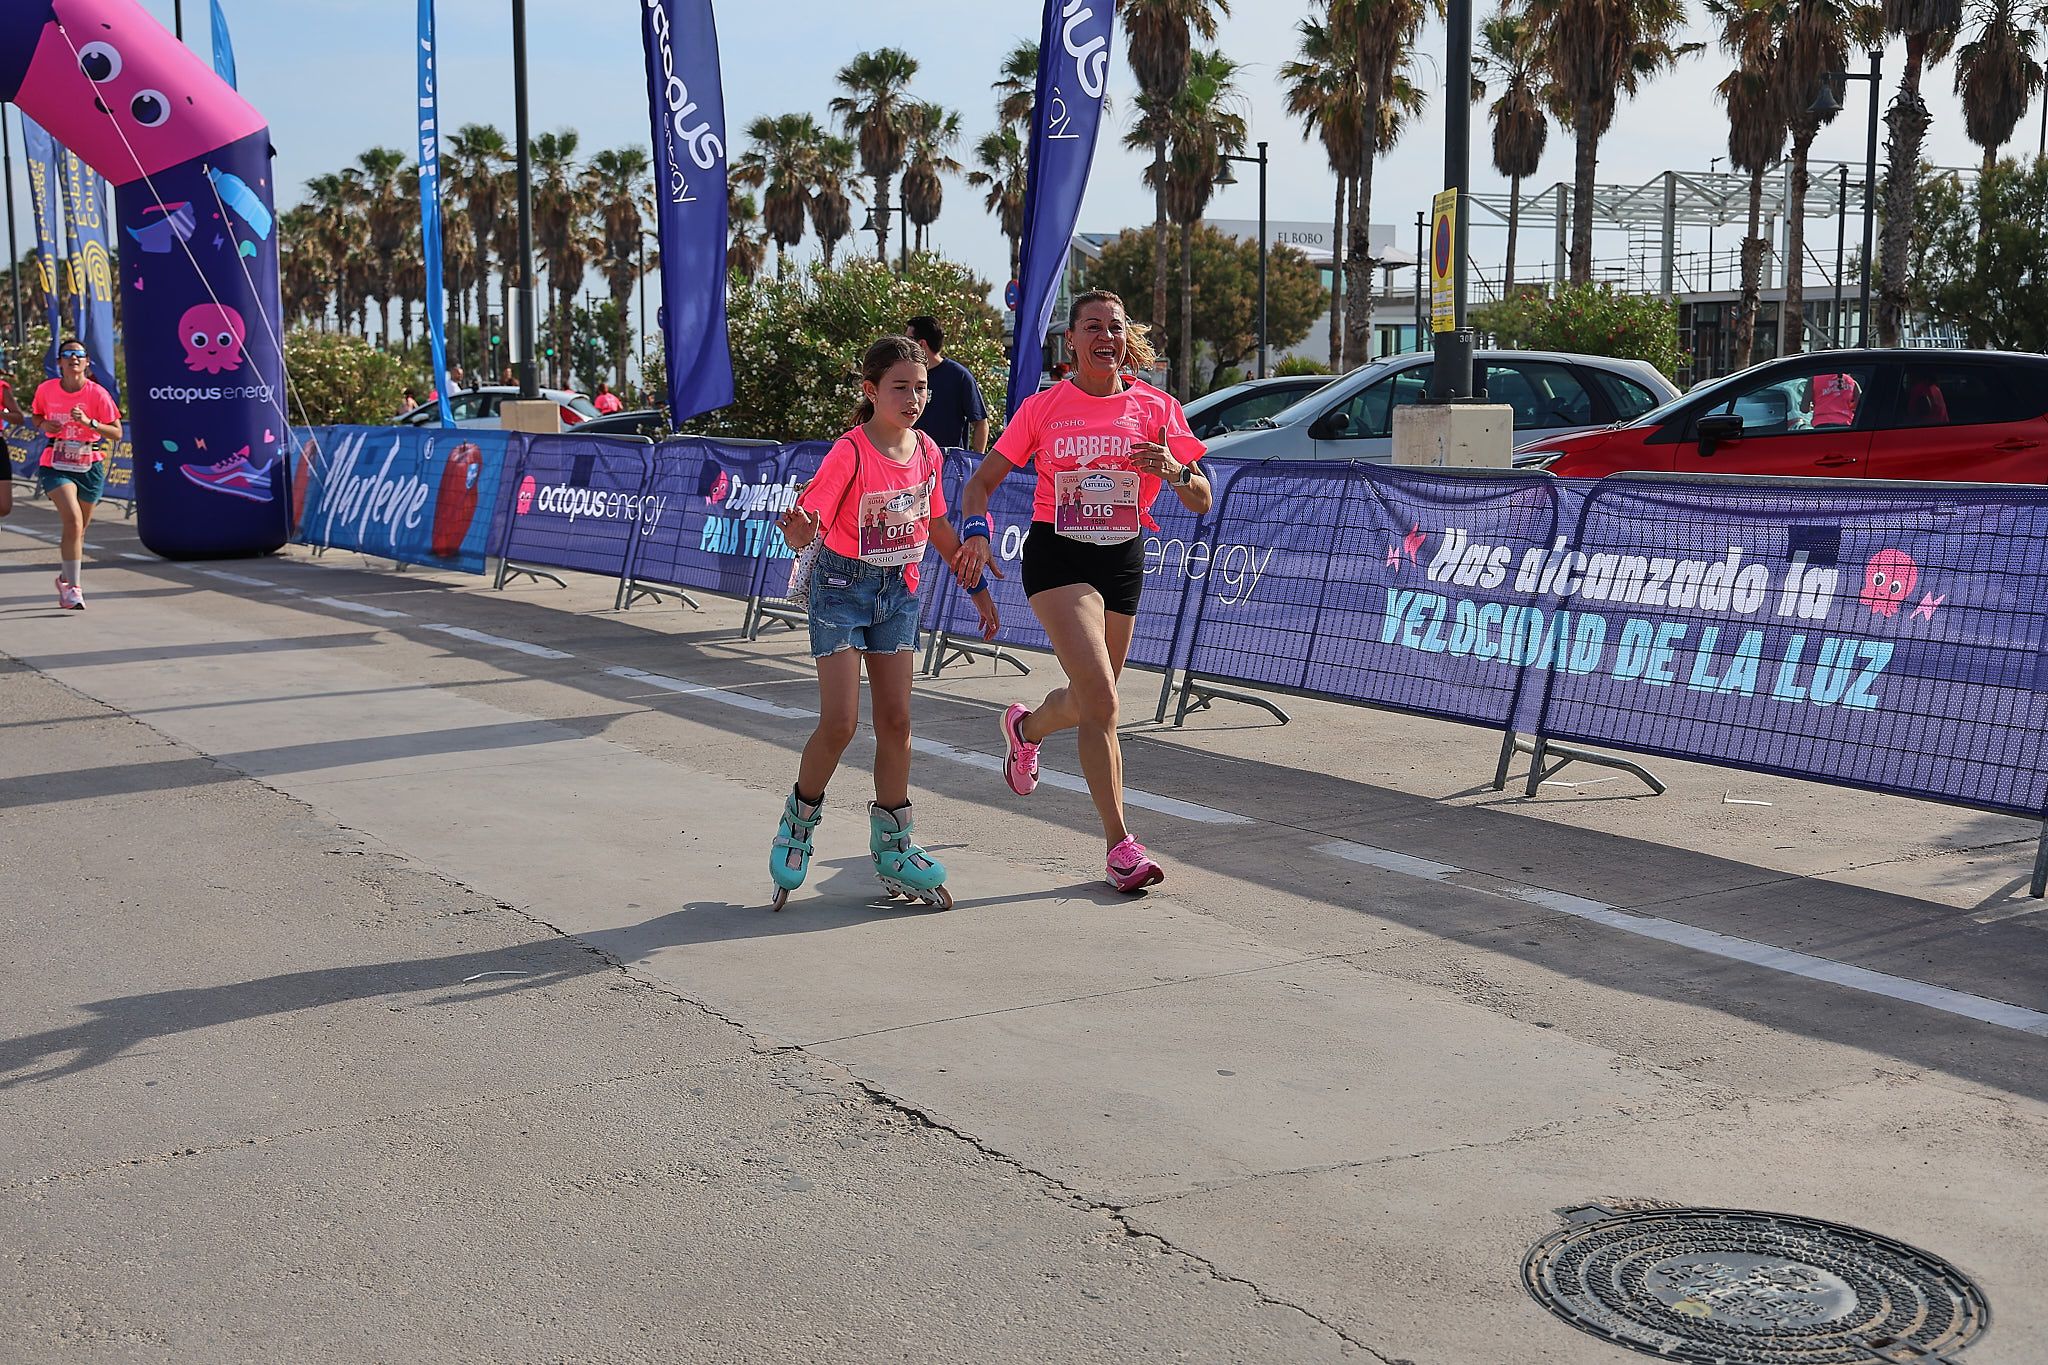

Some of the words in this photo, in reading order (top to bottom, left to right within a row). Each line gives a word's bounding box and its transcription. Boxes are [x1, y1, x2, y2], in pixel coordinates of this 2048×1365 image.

[1278, 232, 1290, 243] EL
[1292, 232, 1323, 244] BOBO
[150, 386, 221, 404] octopus
[223, 385, 275, 403] energy
[1051, 420, 1085, 429] OYSHO
[1055, 436, 1131, 458] CARRERA
[318, 432, 428, 548] Marlene
[538, 483, 607, 523] octopus
[606, 493, 666, 535] energy
[1083, 504, 1113, 516] 016
[700, 515, 740, 555] PARA
[744, 519, 770, 557] TU
[887, 521, 914, 538] 016
[1143, 536, 1273, 606] energy
[1427, 528, 1512, 588] Has
[1514, 536, 1769, 614] alcanzado
[1777, 550, 1838, 620] la
[1380, 587, 1607, 675] VELOCIDAD
[1612, 618, 1688, 687] DE
[1687, 626, 1765, 697] LA
[1772, 635, 1894, 711] LUZ
